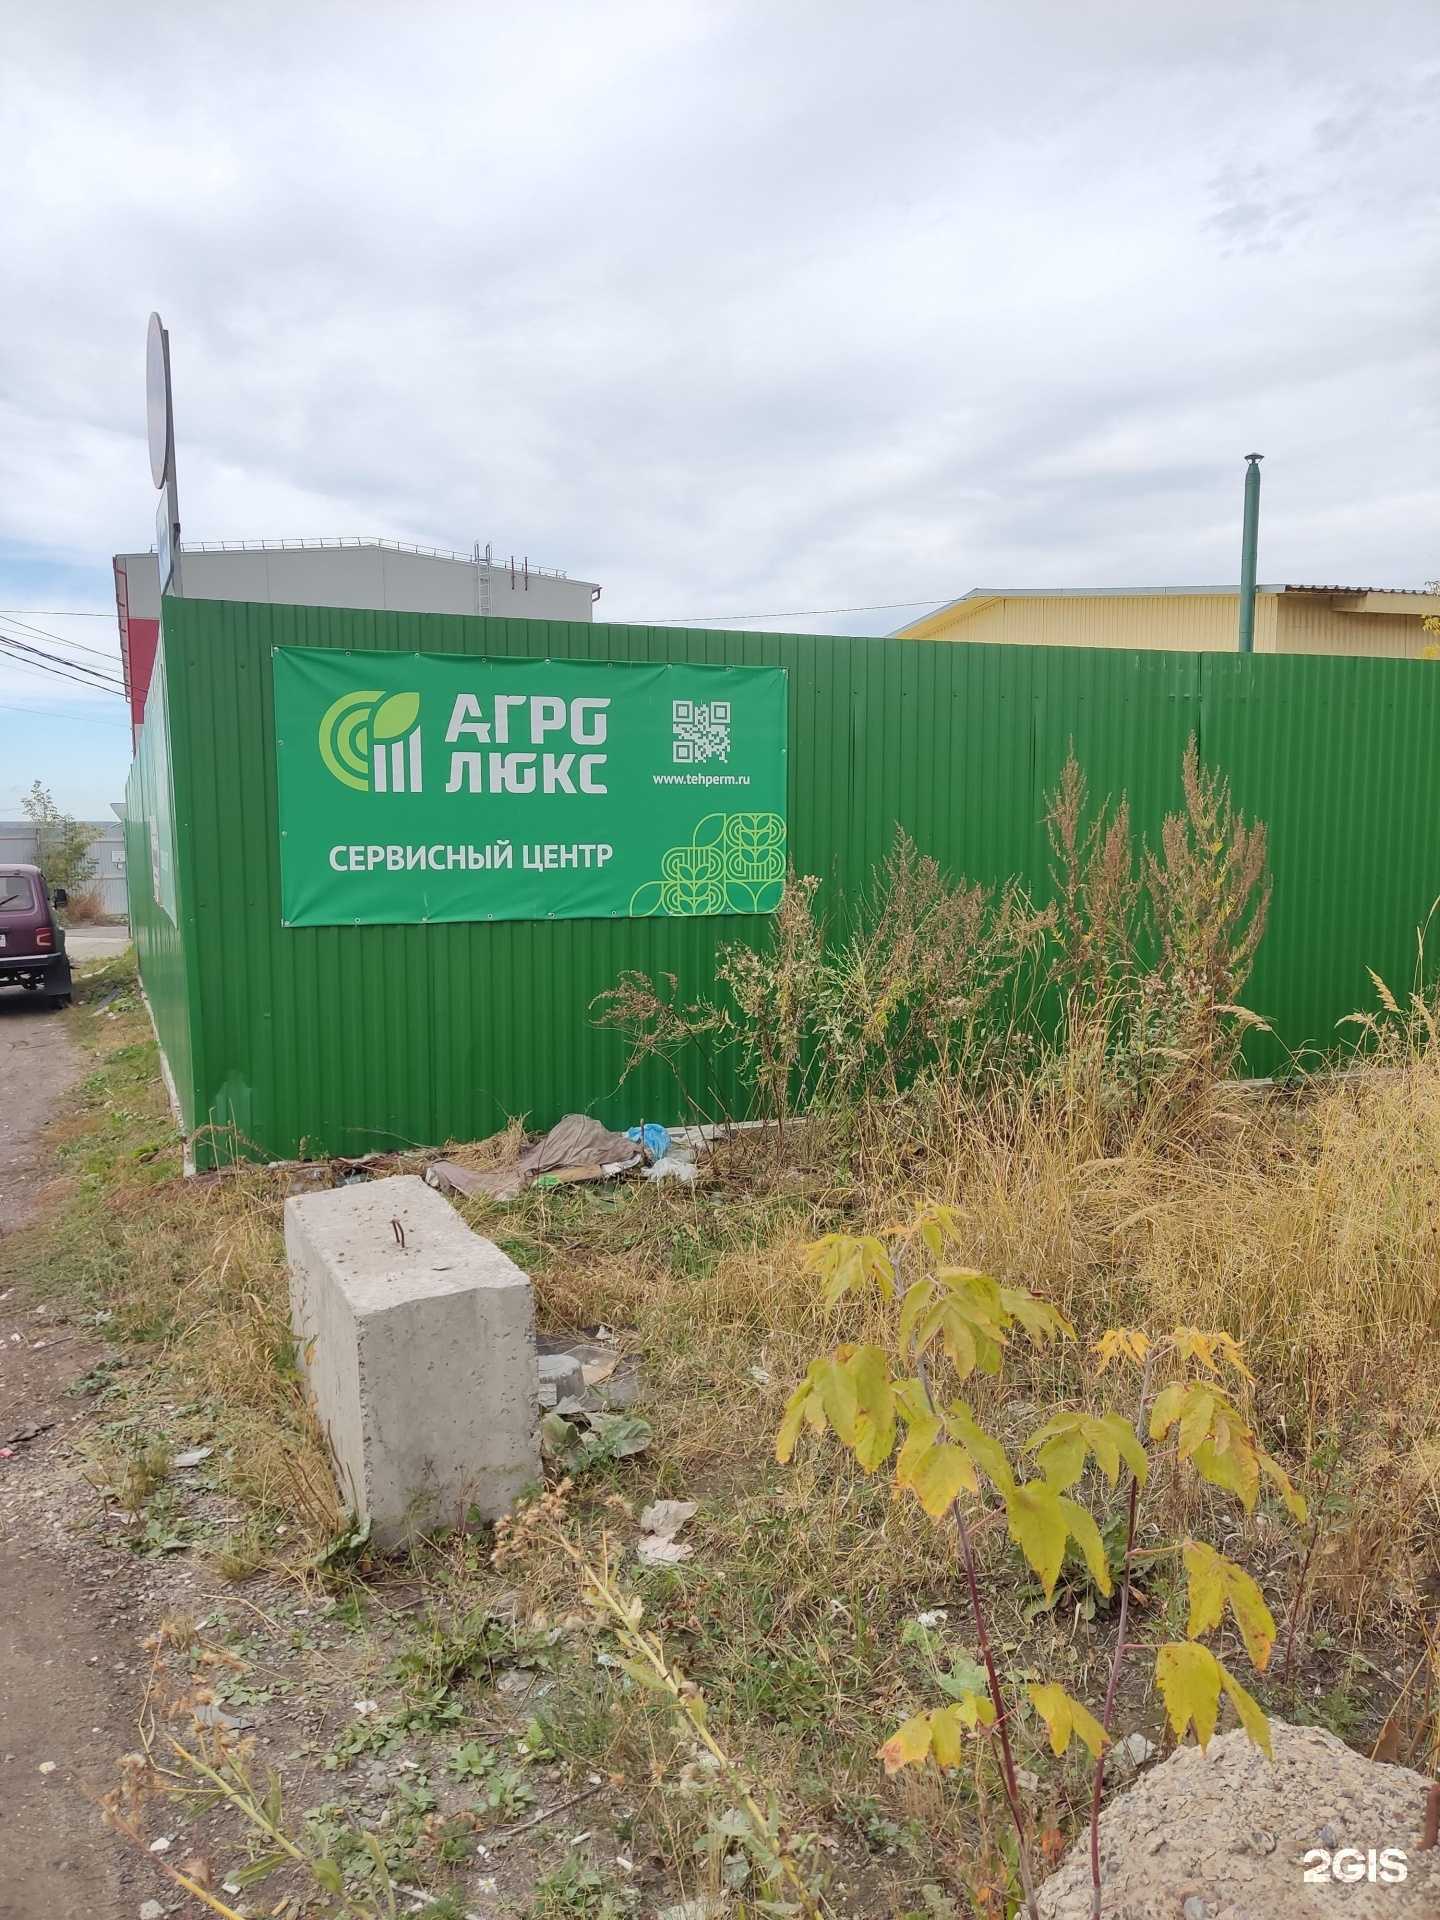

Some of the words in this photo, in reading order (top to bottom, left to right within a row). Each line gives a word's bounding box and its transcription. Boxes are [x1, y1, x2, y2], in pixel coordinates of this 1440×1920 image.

[444, 693, 611, 745] АГРО
[445, 751, 608, 794] ЛЮКС
[652, 773, 751, 788] www.tehperm.ru
[329, 839, 513, 871] СЕРВИСНЫЙ
[522, 844, 613, 872] ЦЕНТР
